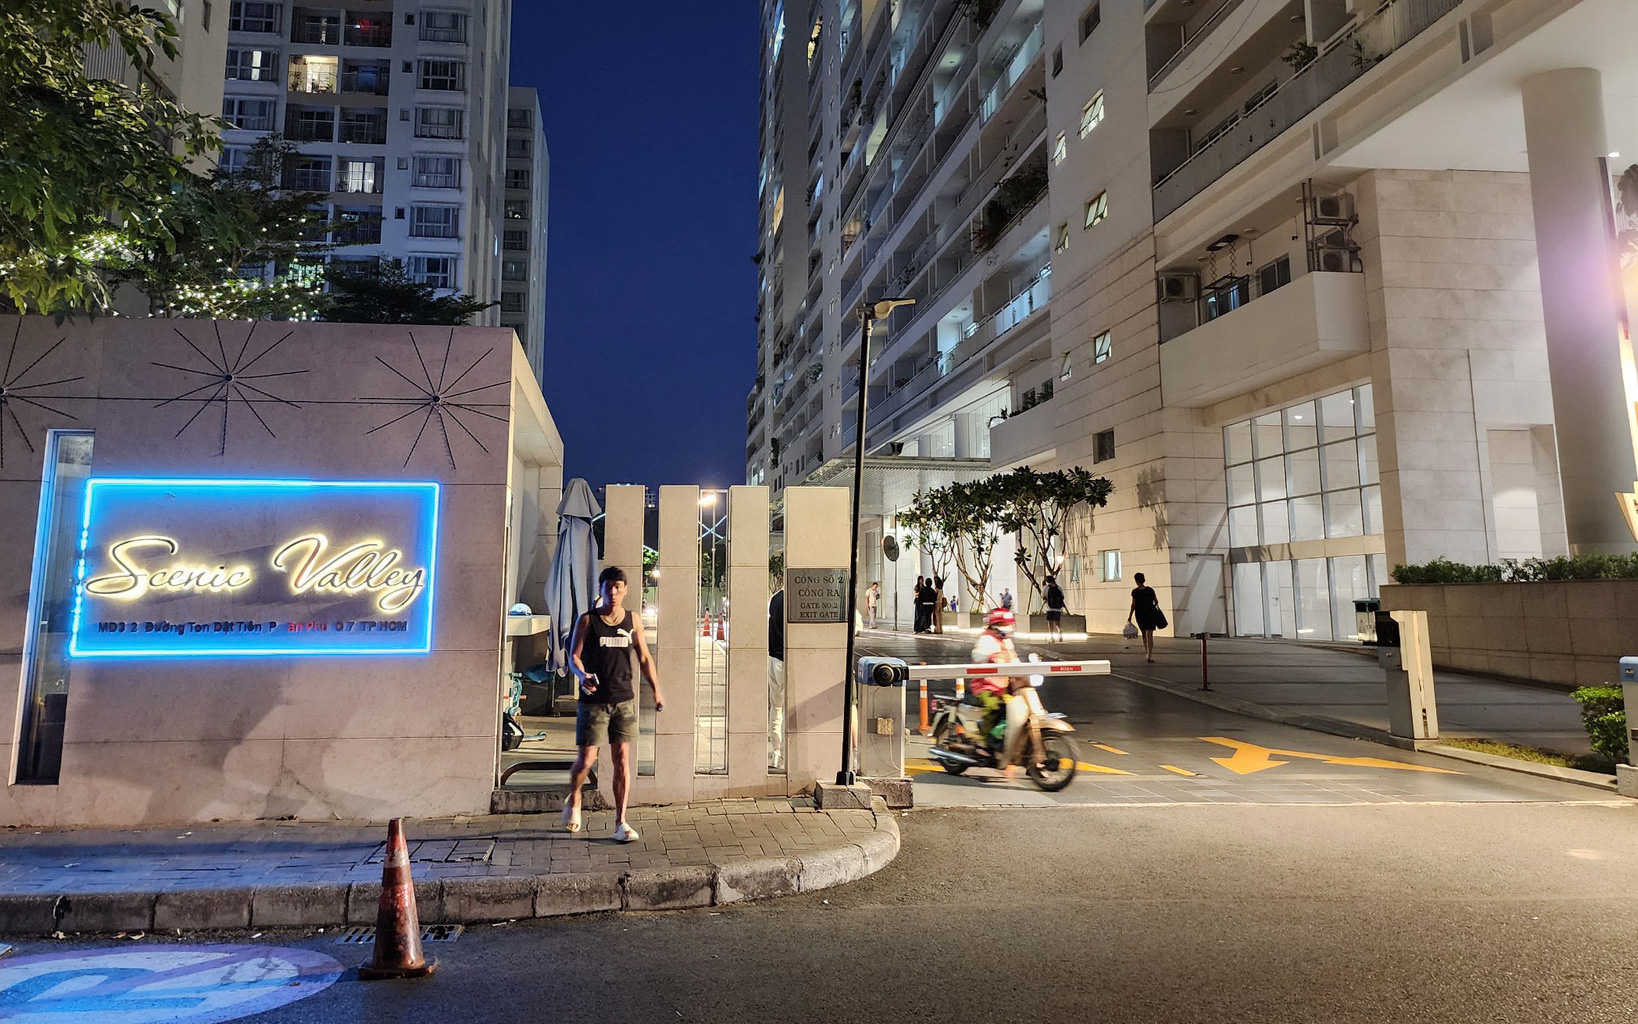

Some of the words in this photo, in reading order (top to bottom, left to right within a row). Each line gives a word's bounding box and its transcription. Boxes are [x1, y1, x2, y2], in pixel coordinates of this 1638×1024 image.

[85, 534, 252, 598] Scenic
[272, 533, 424, 612] Valley
[838, 576, 844, 584] 2
[827, 589, 840, 597] RA
[269, 621, 278, 633] P
[347, 621, 355, 632] 7
